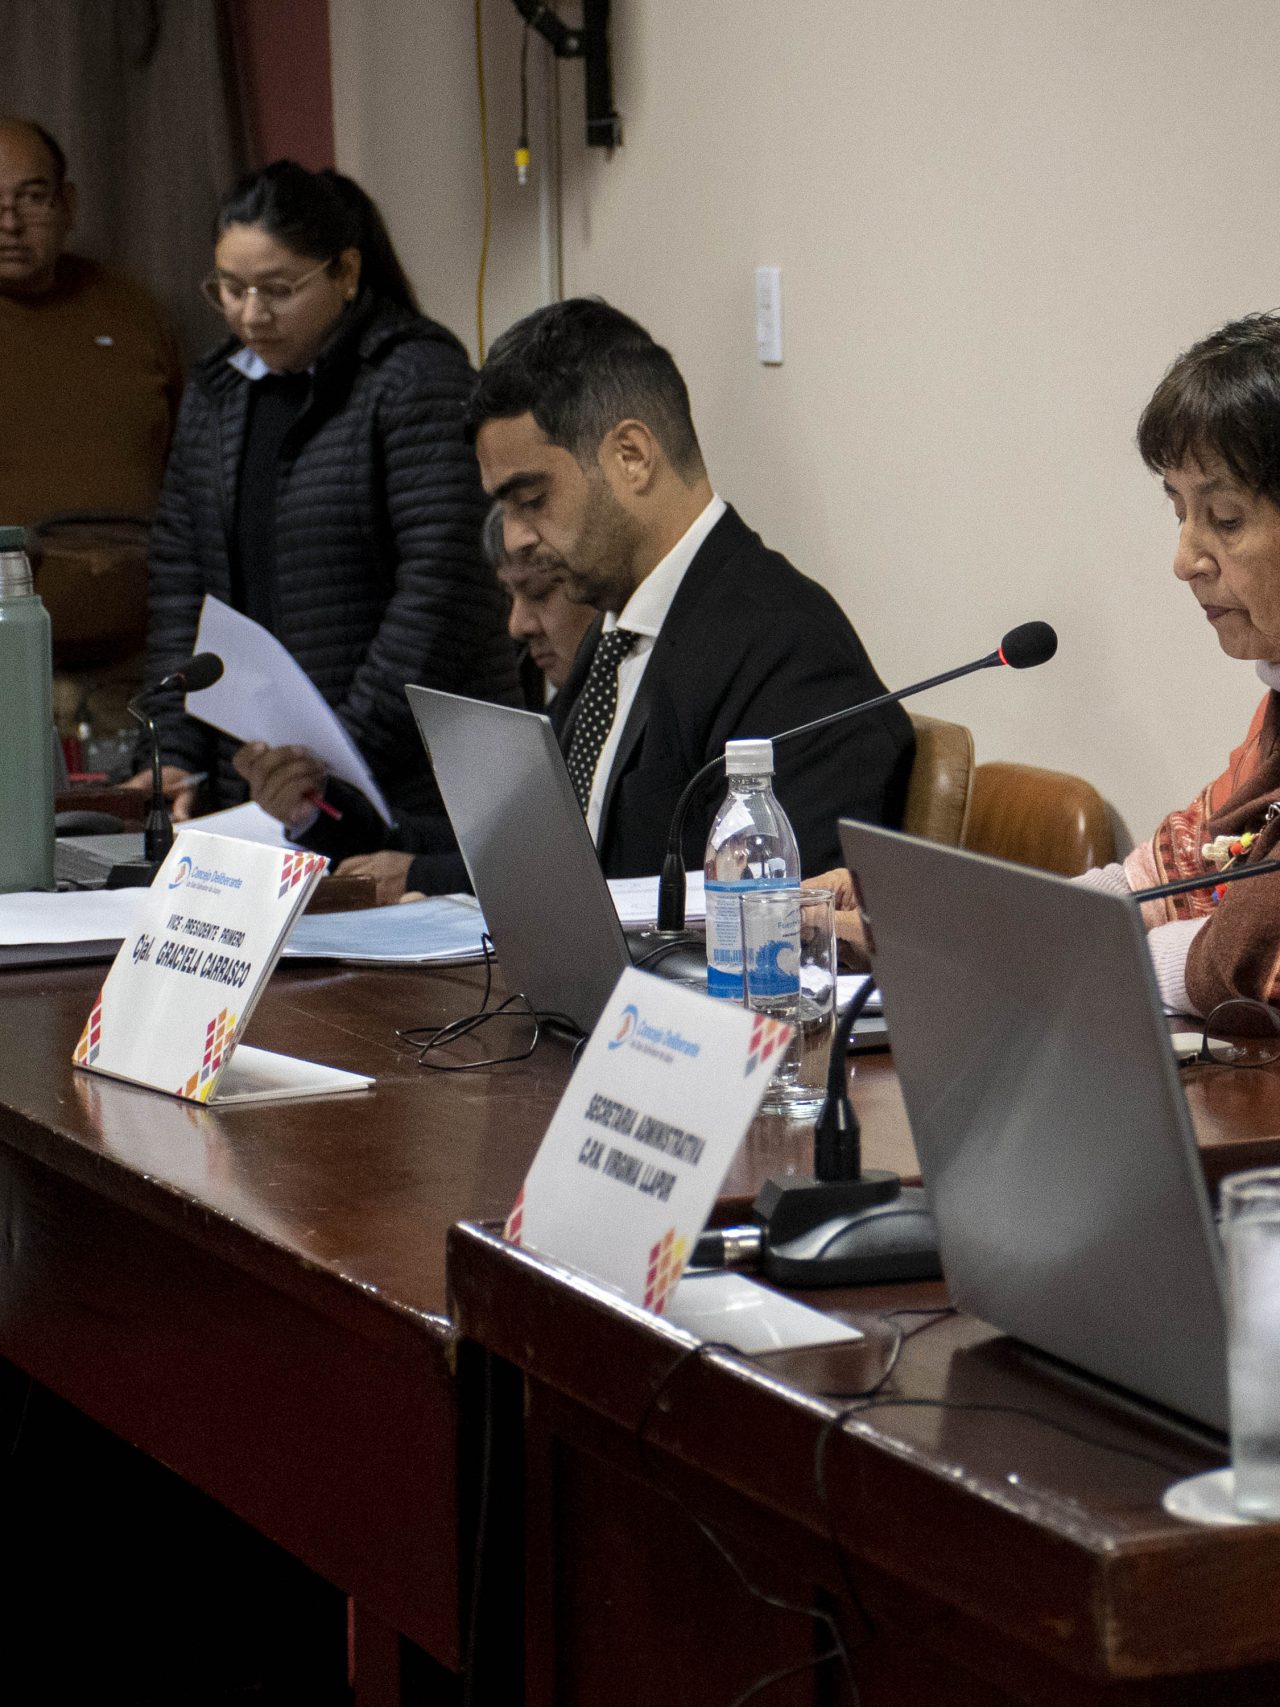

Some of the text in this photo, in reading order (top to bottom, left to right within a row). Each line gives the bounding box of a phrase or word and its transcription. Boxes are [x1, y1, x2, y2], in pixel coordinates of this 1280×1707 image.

[166, 914, 184, 931] VICE
[182, 918, 220, 941] PRESIDENTE
[218, 927, 246, 948] PRIMERO
[155, 940, 204, 975] GRACIELA
[200, 950, 251, 989] CARRASCO
